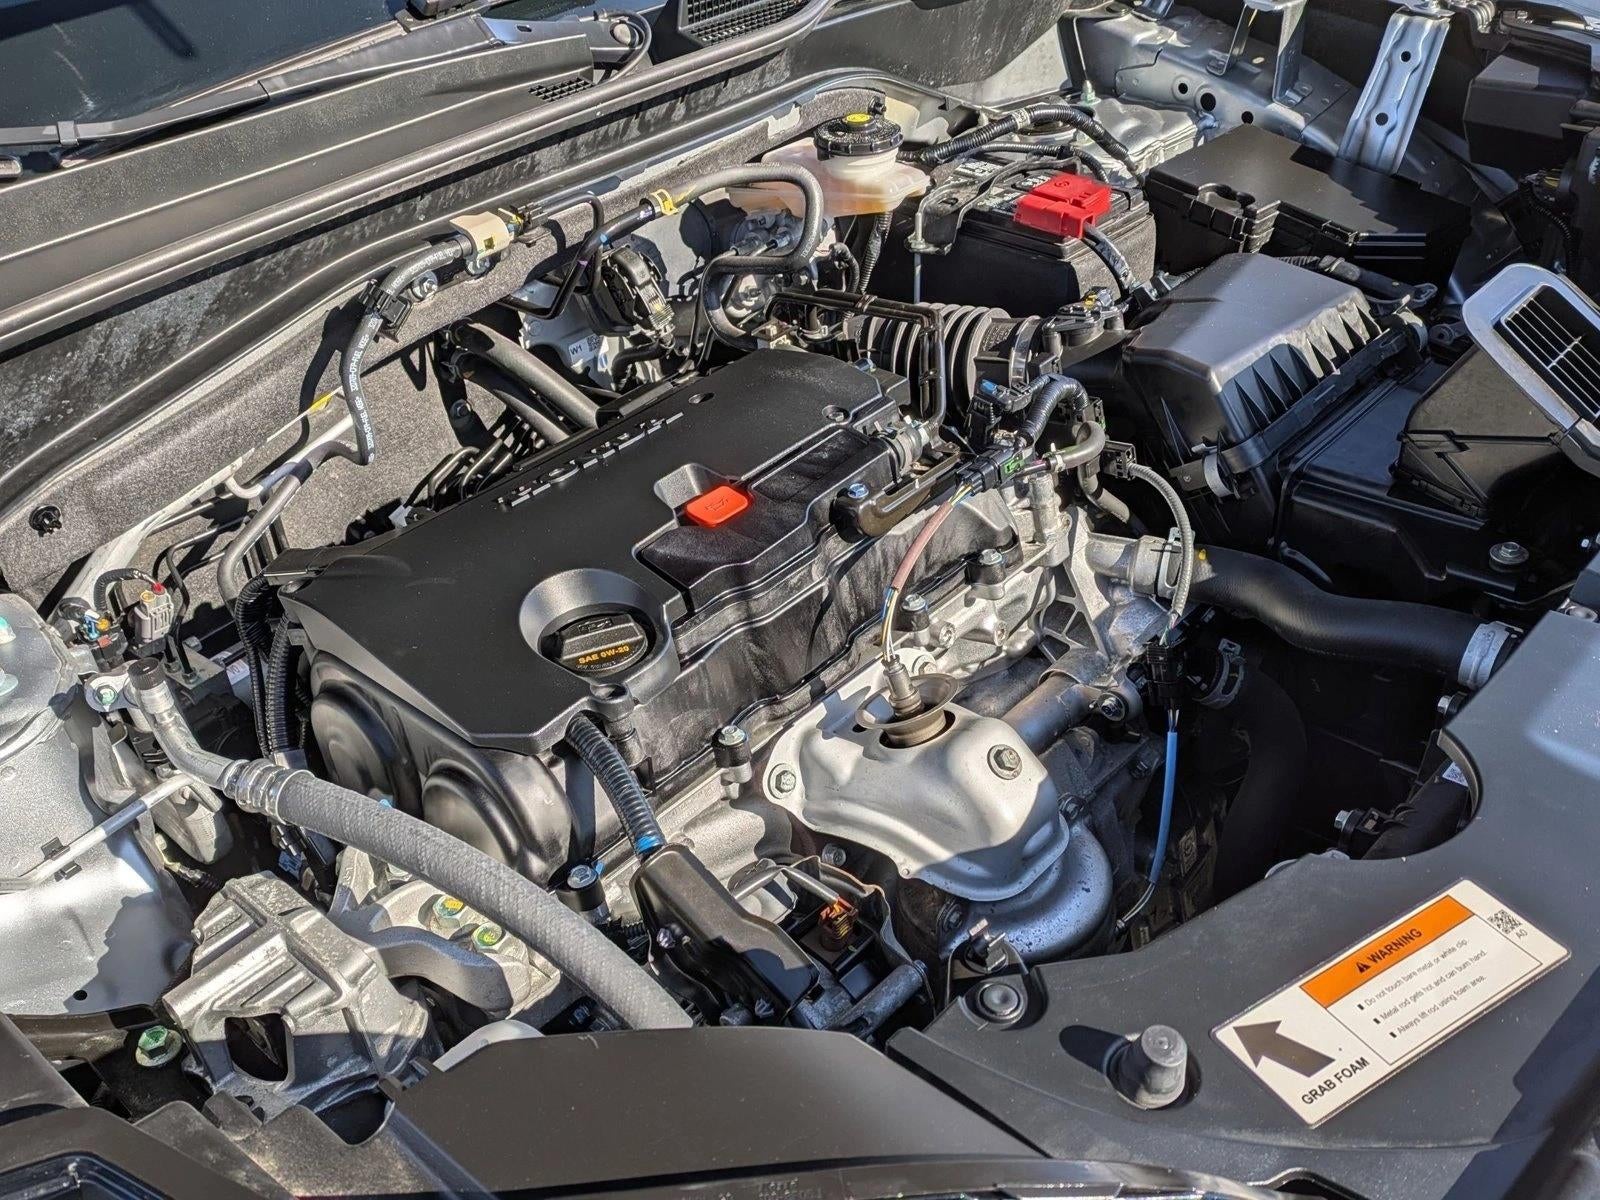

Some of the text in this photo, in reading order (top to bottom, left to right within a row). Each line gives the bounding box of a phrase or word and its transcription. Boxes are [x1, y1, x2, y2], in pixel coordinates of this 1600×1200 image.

[570, 344, 582, 355] W1
[578, 654, 599, 664] SAE
[600, 645, 630, 658] 0W-20
[1367, 928, 1422, 963] WARNING
[1364, 998, 1377, 1007] Do
[1375, 991, 1387, 1000] not
[1385, 978, 1404, 993] touch
[1402, 971, 1417, 982] bare
[1417, 960, 1434, 973] metal
[1440, 946, 1457, 959] white
[1380, 1005, 1400, 1020] Metal
[1399, 998, 1411, 1008] rod
[1410, 990, 1424, 1003] gets
[1422, 984, 1434, 994] hot
[1434, 976, 1446, 987] and
[1445, 970, 1457, 979] can
[1455, 961, 1470, 973] burn
[1397, 1016, 1420, 1034] Always
[1418, 1009, 1429, 1019] lift
[1427, 1003, 1440, 1014] rod
[1439, 993, 1457, 1007] using
[1453, 983, 1471, 996] foam
[1301, 1056, 1371, 1105] GRAB FOAM
